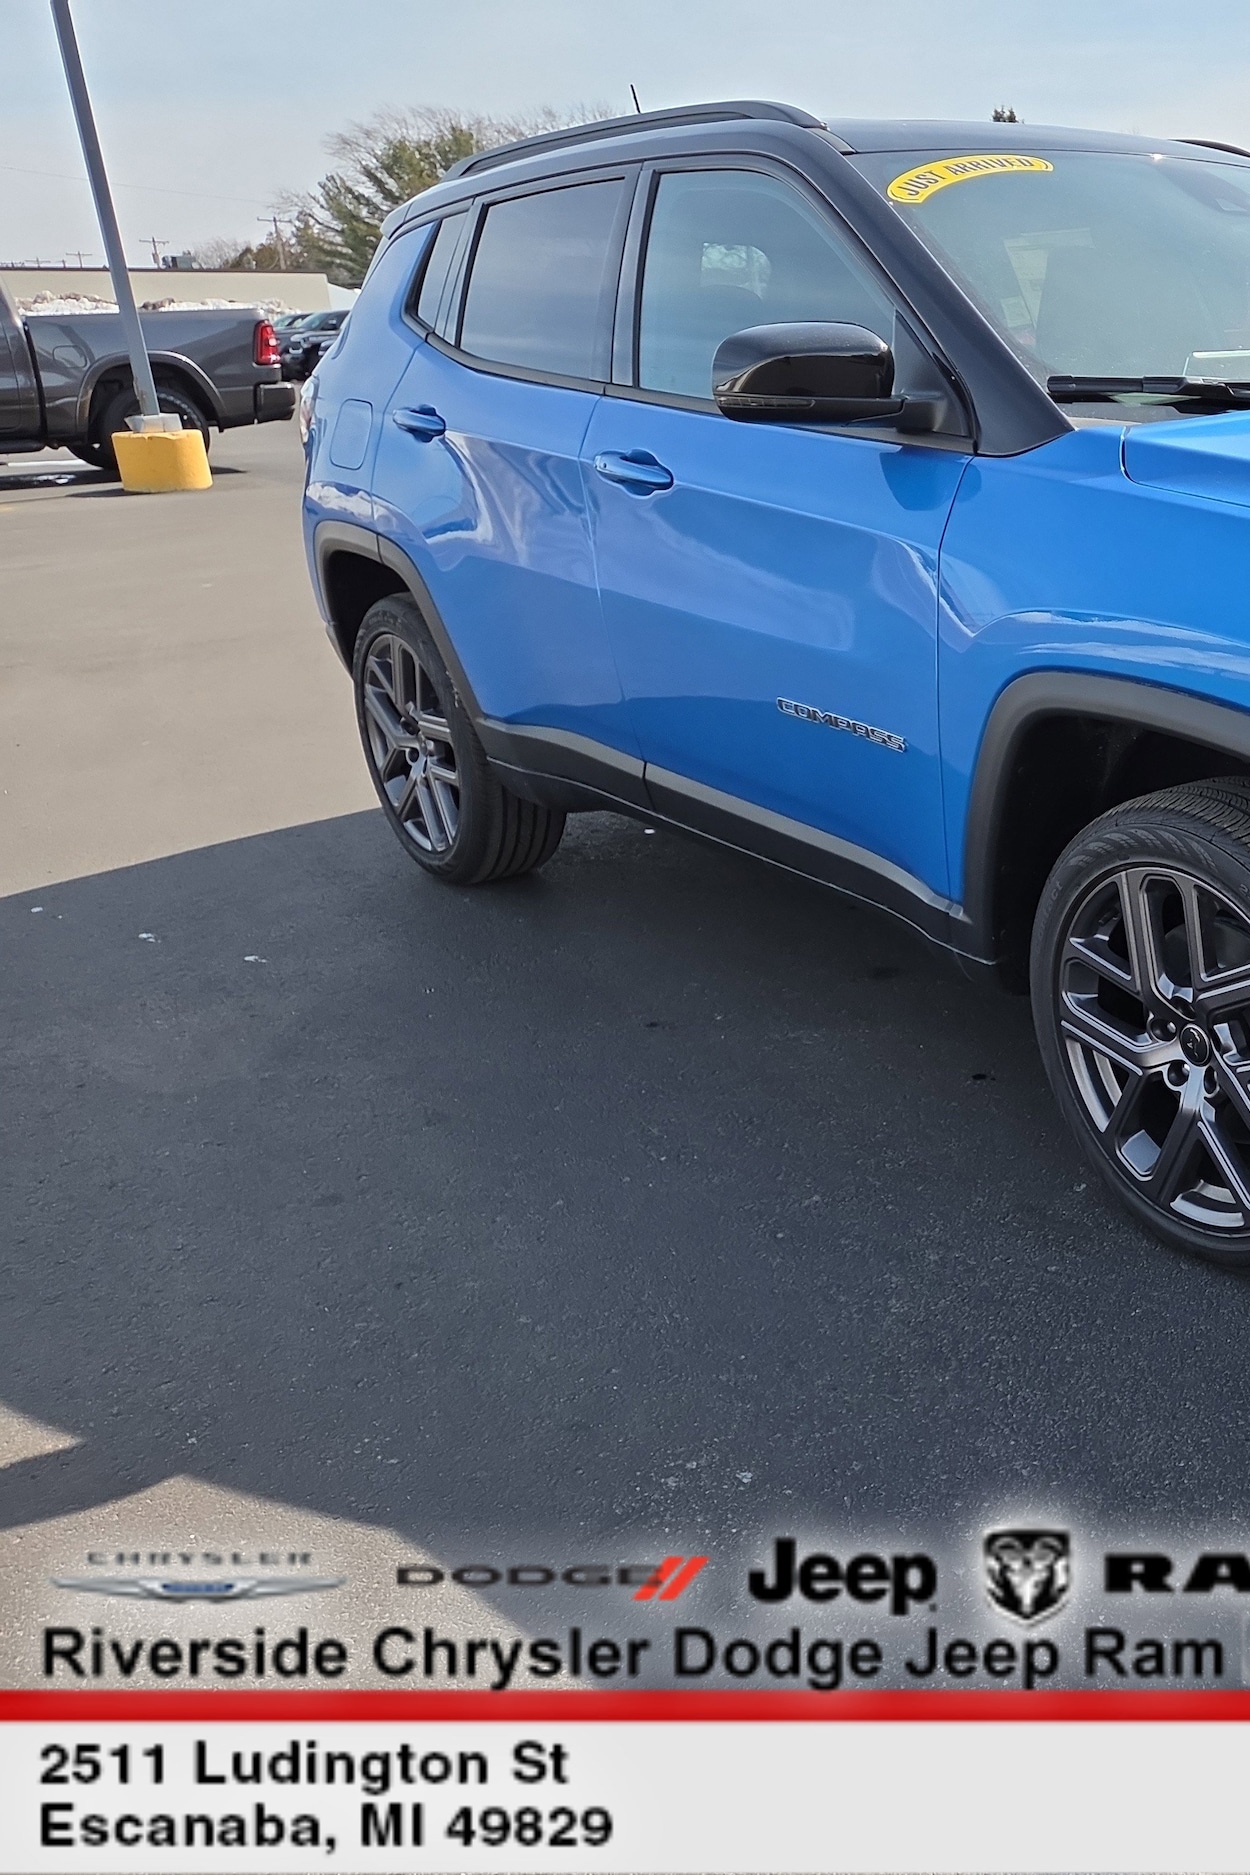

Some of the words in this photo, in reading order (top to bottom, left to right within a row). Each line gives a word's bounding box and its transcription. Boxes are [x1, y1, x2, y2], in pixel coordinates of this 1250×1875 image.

[897, 170, 947, 197] JUST
[944, 157, 1035, 177] ARRIVED
[776, 696, 909, 754] COMPASS
